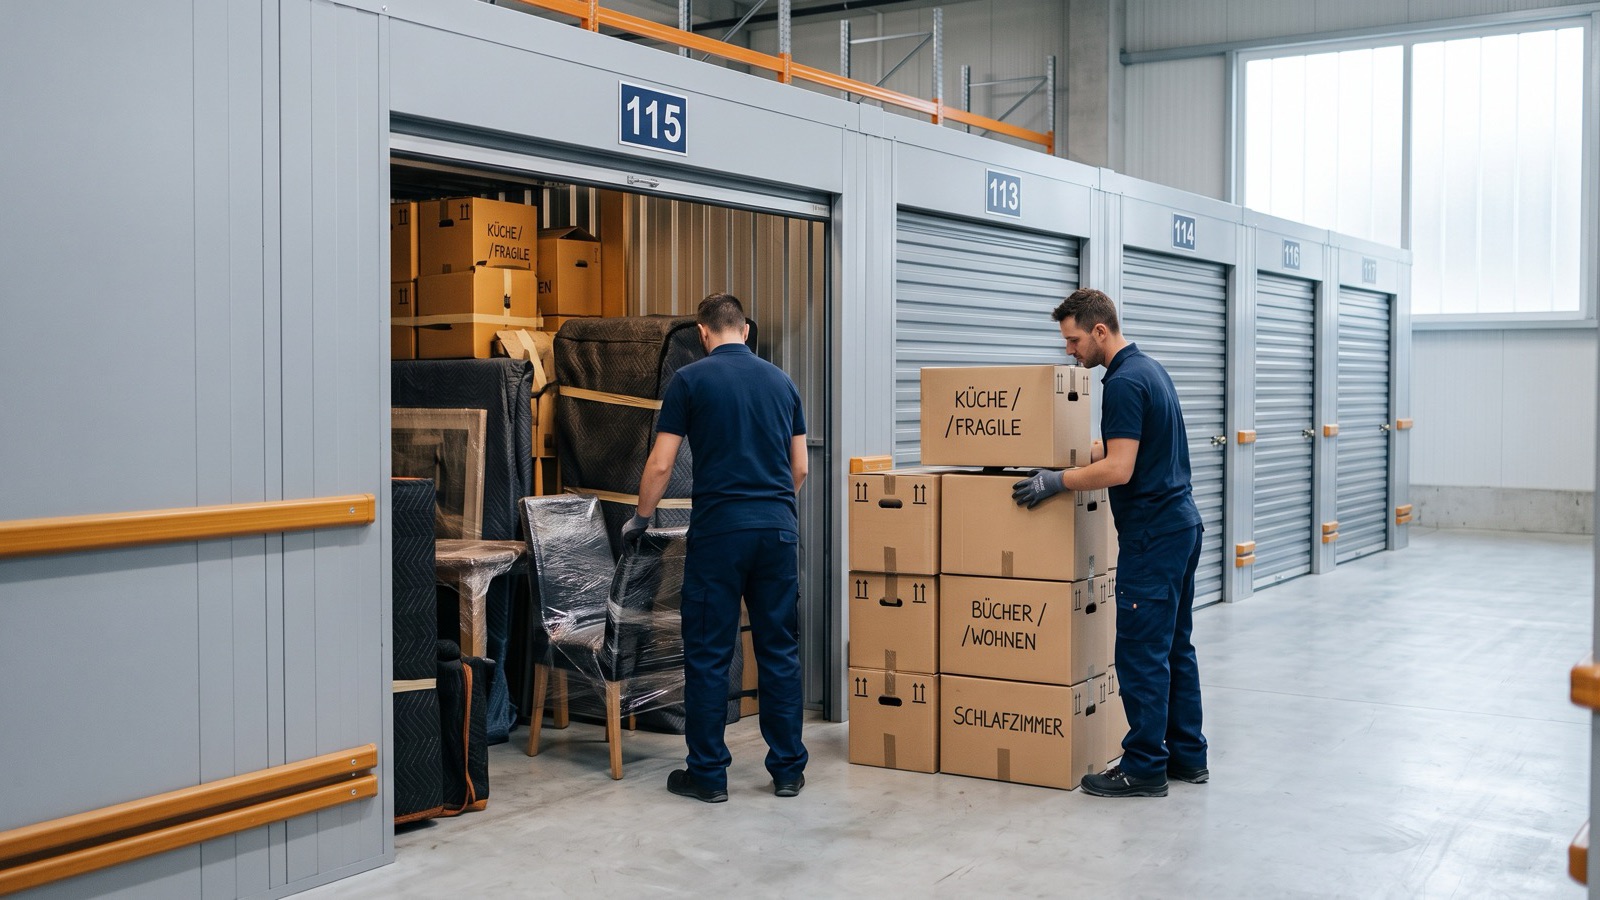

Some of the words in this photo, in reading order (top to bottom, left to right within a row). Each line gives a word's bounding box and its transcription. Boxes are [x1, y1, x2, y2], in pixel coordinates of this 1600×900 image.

[626, 95, 682, 143] 115
[990, 178, 1019, 211] 113
[1175, 219, 1194, 246] 114
[488, 242, 530, 261] /FRAGILE
[1284, 244, 1299, 267] 116
[945, 415, 1022, 438] /FRAGILE
[961, 625, 1036, 650] /WOHNEN
[953, 706, 1065, 738] SCHLAFZIMMER
